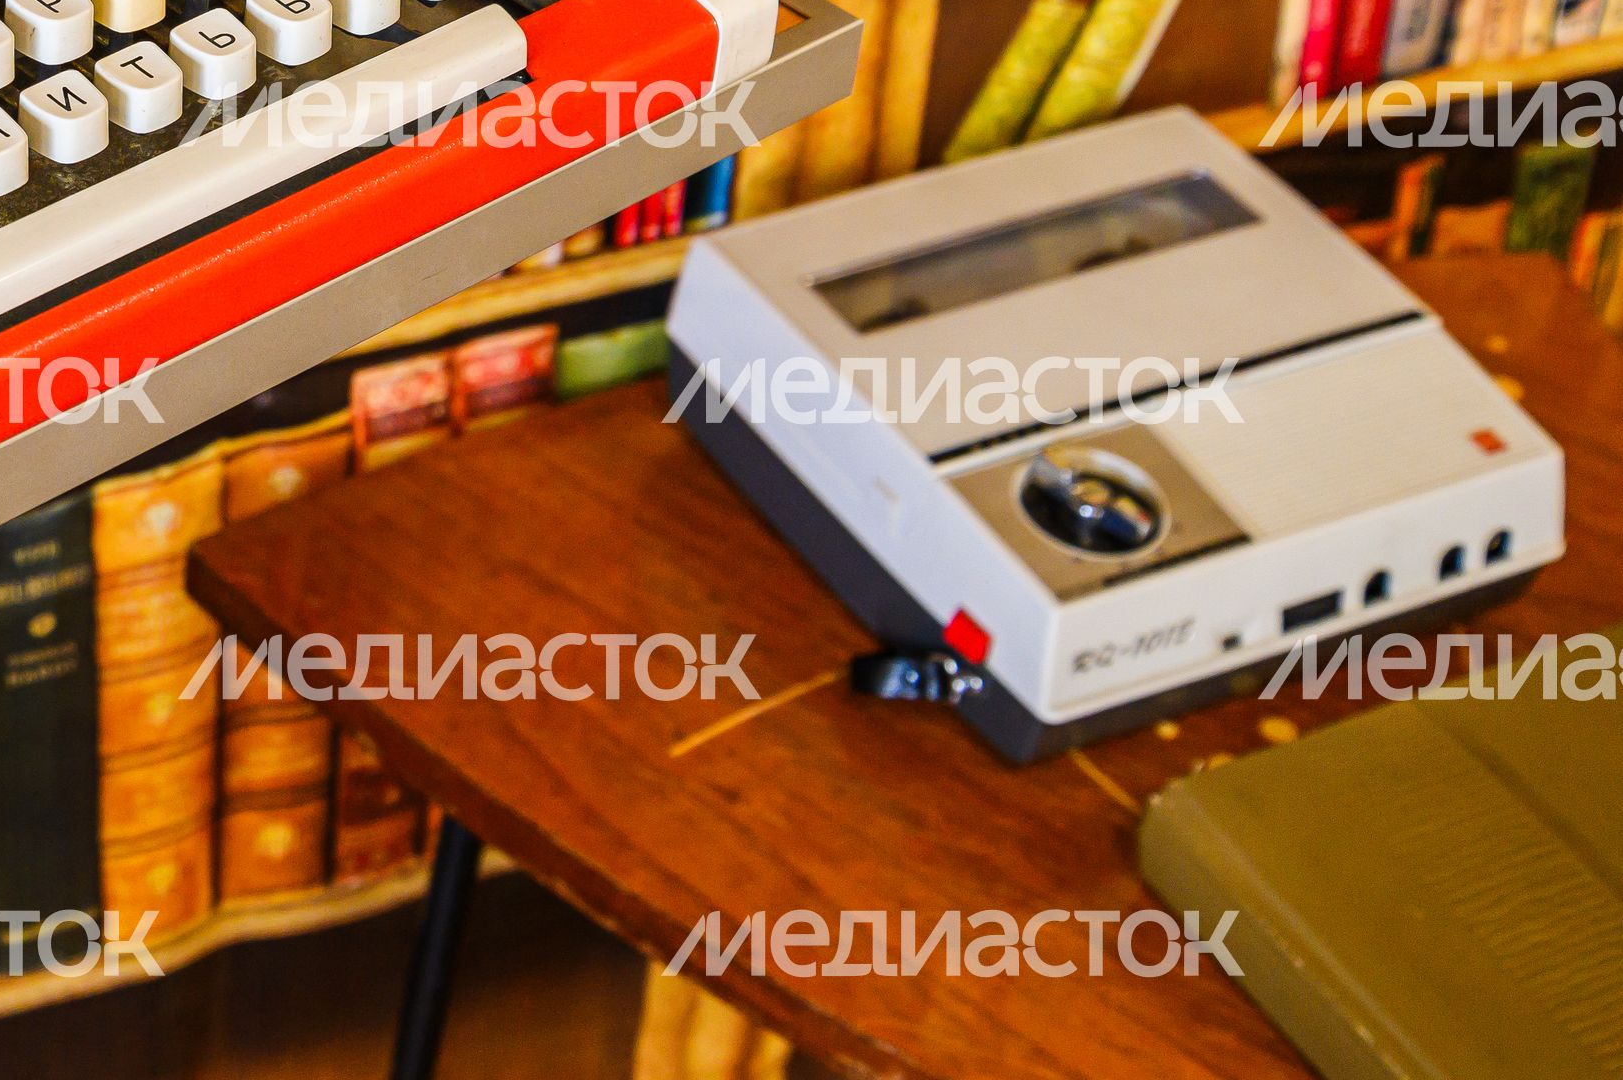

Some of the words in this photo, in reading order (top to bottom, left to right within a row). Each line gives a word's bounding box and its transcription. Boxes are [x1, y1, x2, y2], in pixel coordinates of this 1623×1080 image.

[198, 30, 237, 50] Ь
[119, 54, 155, 80] Т
[46, 85, 88, 112] И
